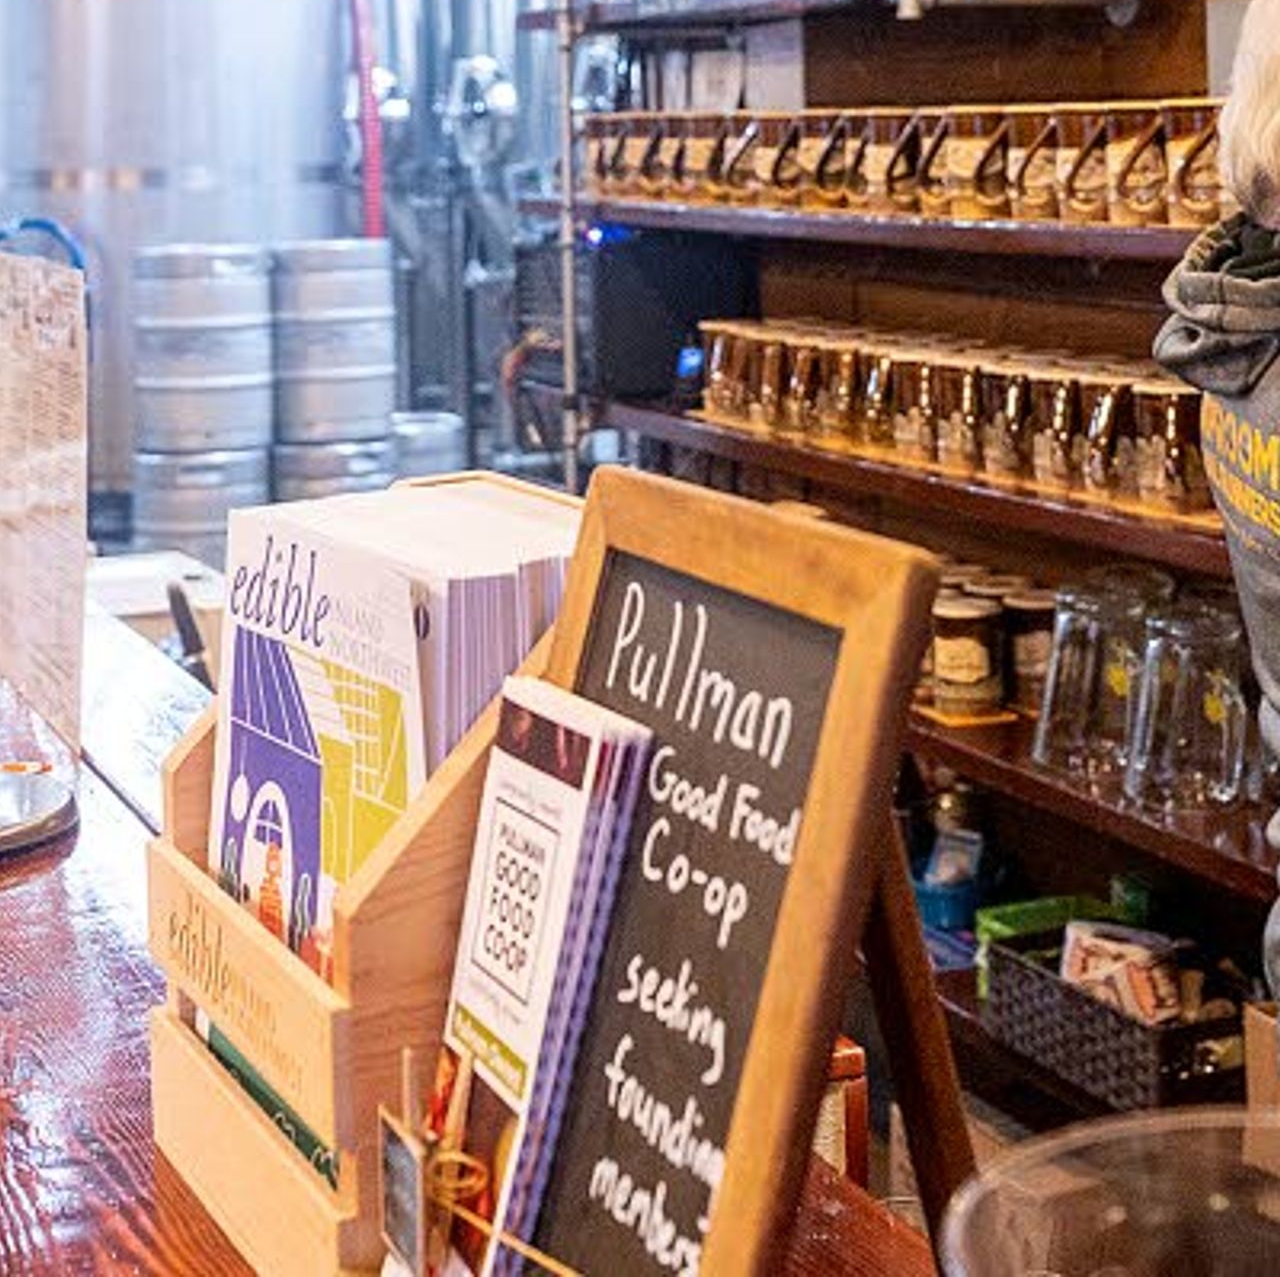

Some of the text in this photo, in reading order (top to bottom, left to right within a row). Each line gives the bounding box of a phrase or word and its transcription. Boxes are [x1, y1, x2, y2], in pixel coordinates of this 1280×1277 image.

[230, 534, 331, 648] edible
[606, 581, 793, 770] Pullman
[648, 744, 728, 833] Good
[728, 782, 802, 866] Food
[488, 884, 536, 941] FOOD
[495, 850, 542, 903] GOOD
[641, 817, 749, 950] Co-op
[617, 953, 726, 1086] seeking
